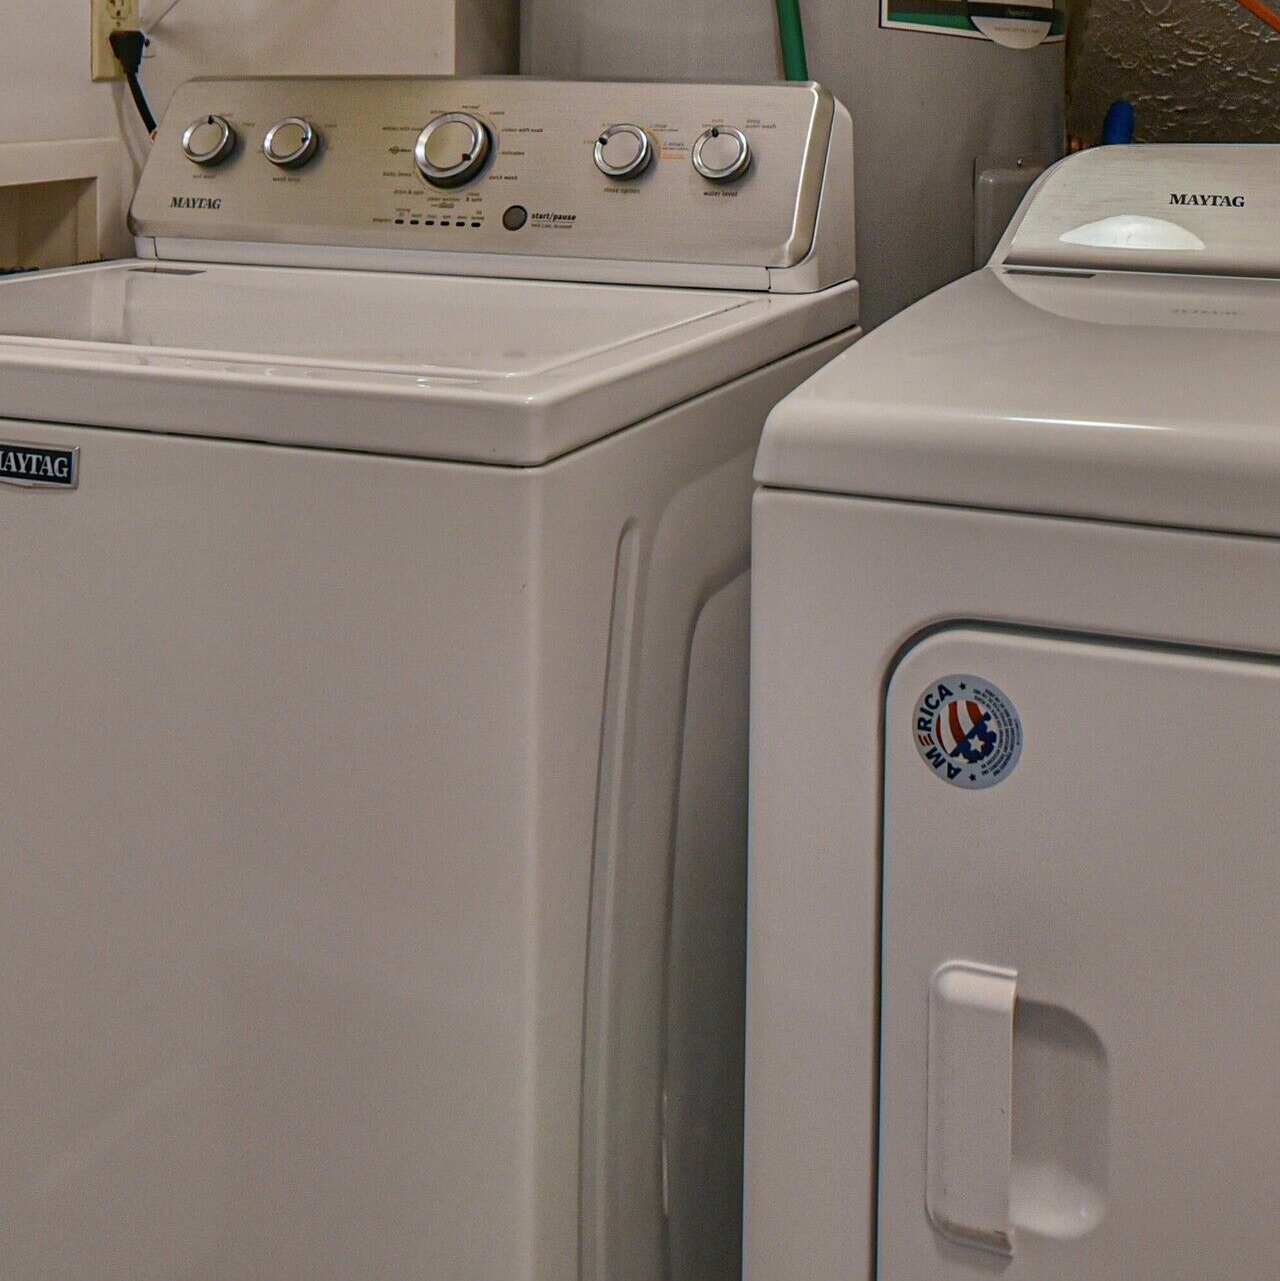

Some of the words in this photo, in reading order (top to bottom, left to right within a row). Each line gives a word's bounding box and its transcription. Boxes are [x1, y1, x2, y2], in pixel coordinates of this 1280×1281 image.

[170, 196, 222, 210] MAYTAG
[1169, 193, 1245, 208] MAYTAG
[531, 212, 577, 221] start/pause
[917, 683, 962, 780] AMERICA
